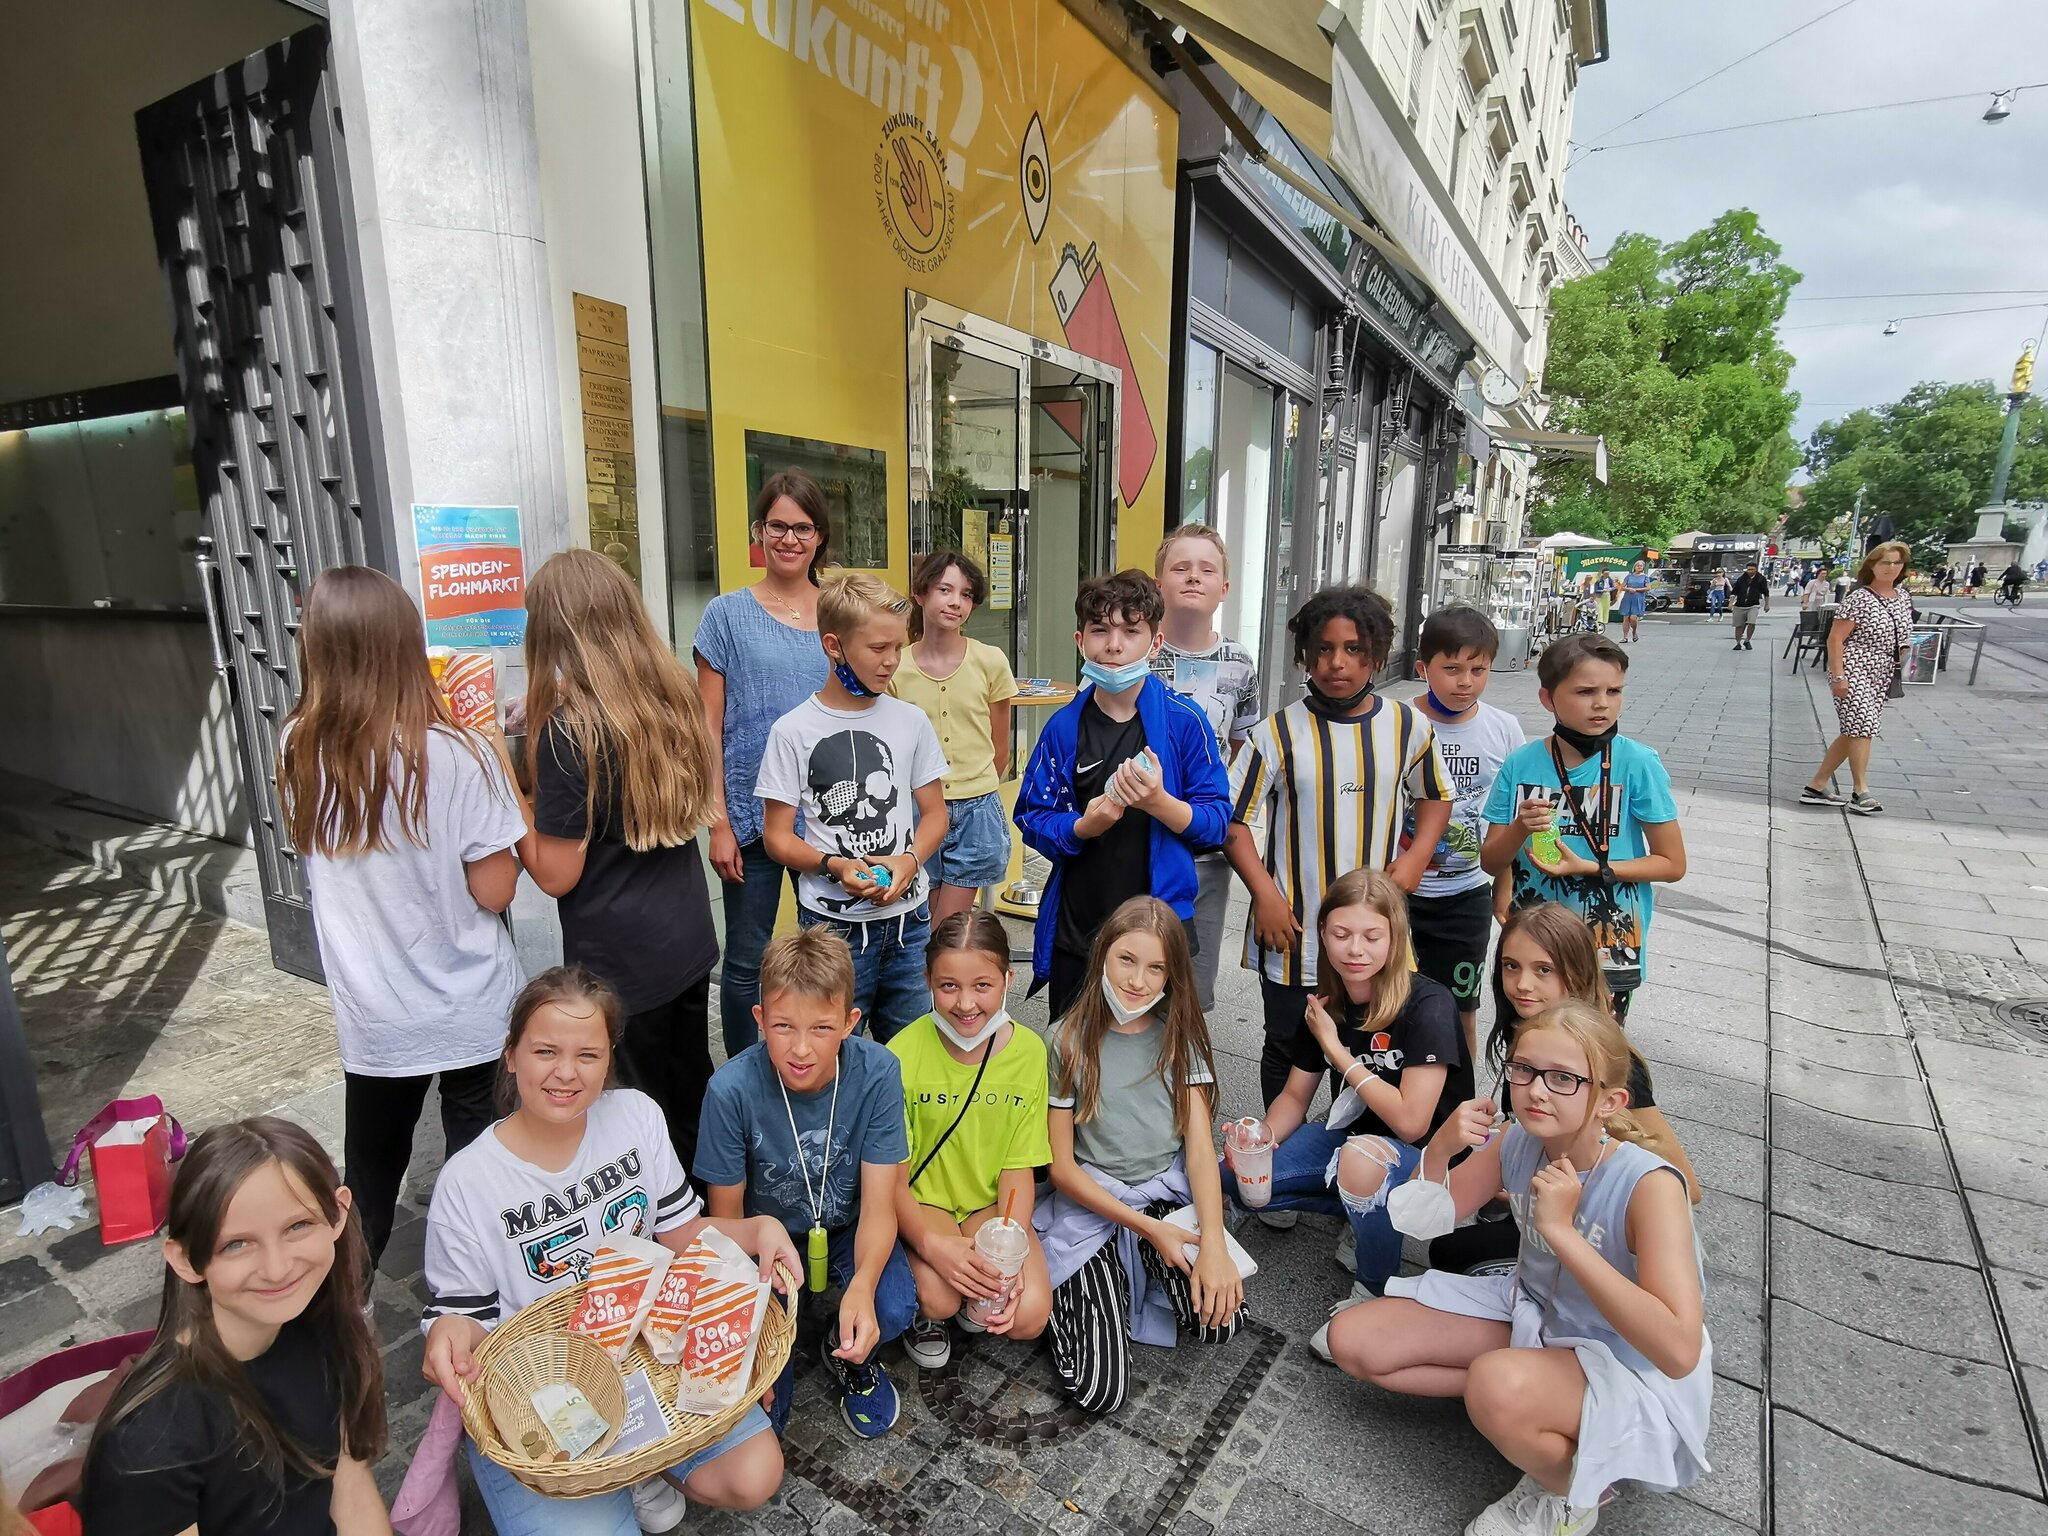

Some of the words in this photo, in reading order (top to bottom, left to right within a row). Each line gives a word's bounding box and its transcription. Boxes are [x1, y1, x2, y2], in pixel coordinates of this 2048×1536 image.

[881, 112, 924, 140] ZUKUNFT
[925, 130, 948, 173] SÄEN
[873, 153, 883, 184] 800
[875, 189, 894, 239] JAHRE
[892, 237, 926, 274] DIÖZESE
[1406, 182, 1500, 350] KIRCHENECK
[1365, 263, 1419, 331] CALZEDONIA
[428, 576, 521, 600] FLOHMARKT
[430, 560, 511, 581] SPENDEN-
[1441, 743, 1461, 756] EEP
[1446, 757, 1478, 775] VING
[501, 1147, 643, 1240] MALIBU
